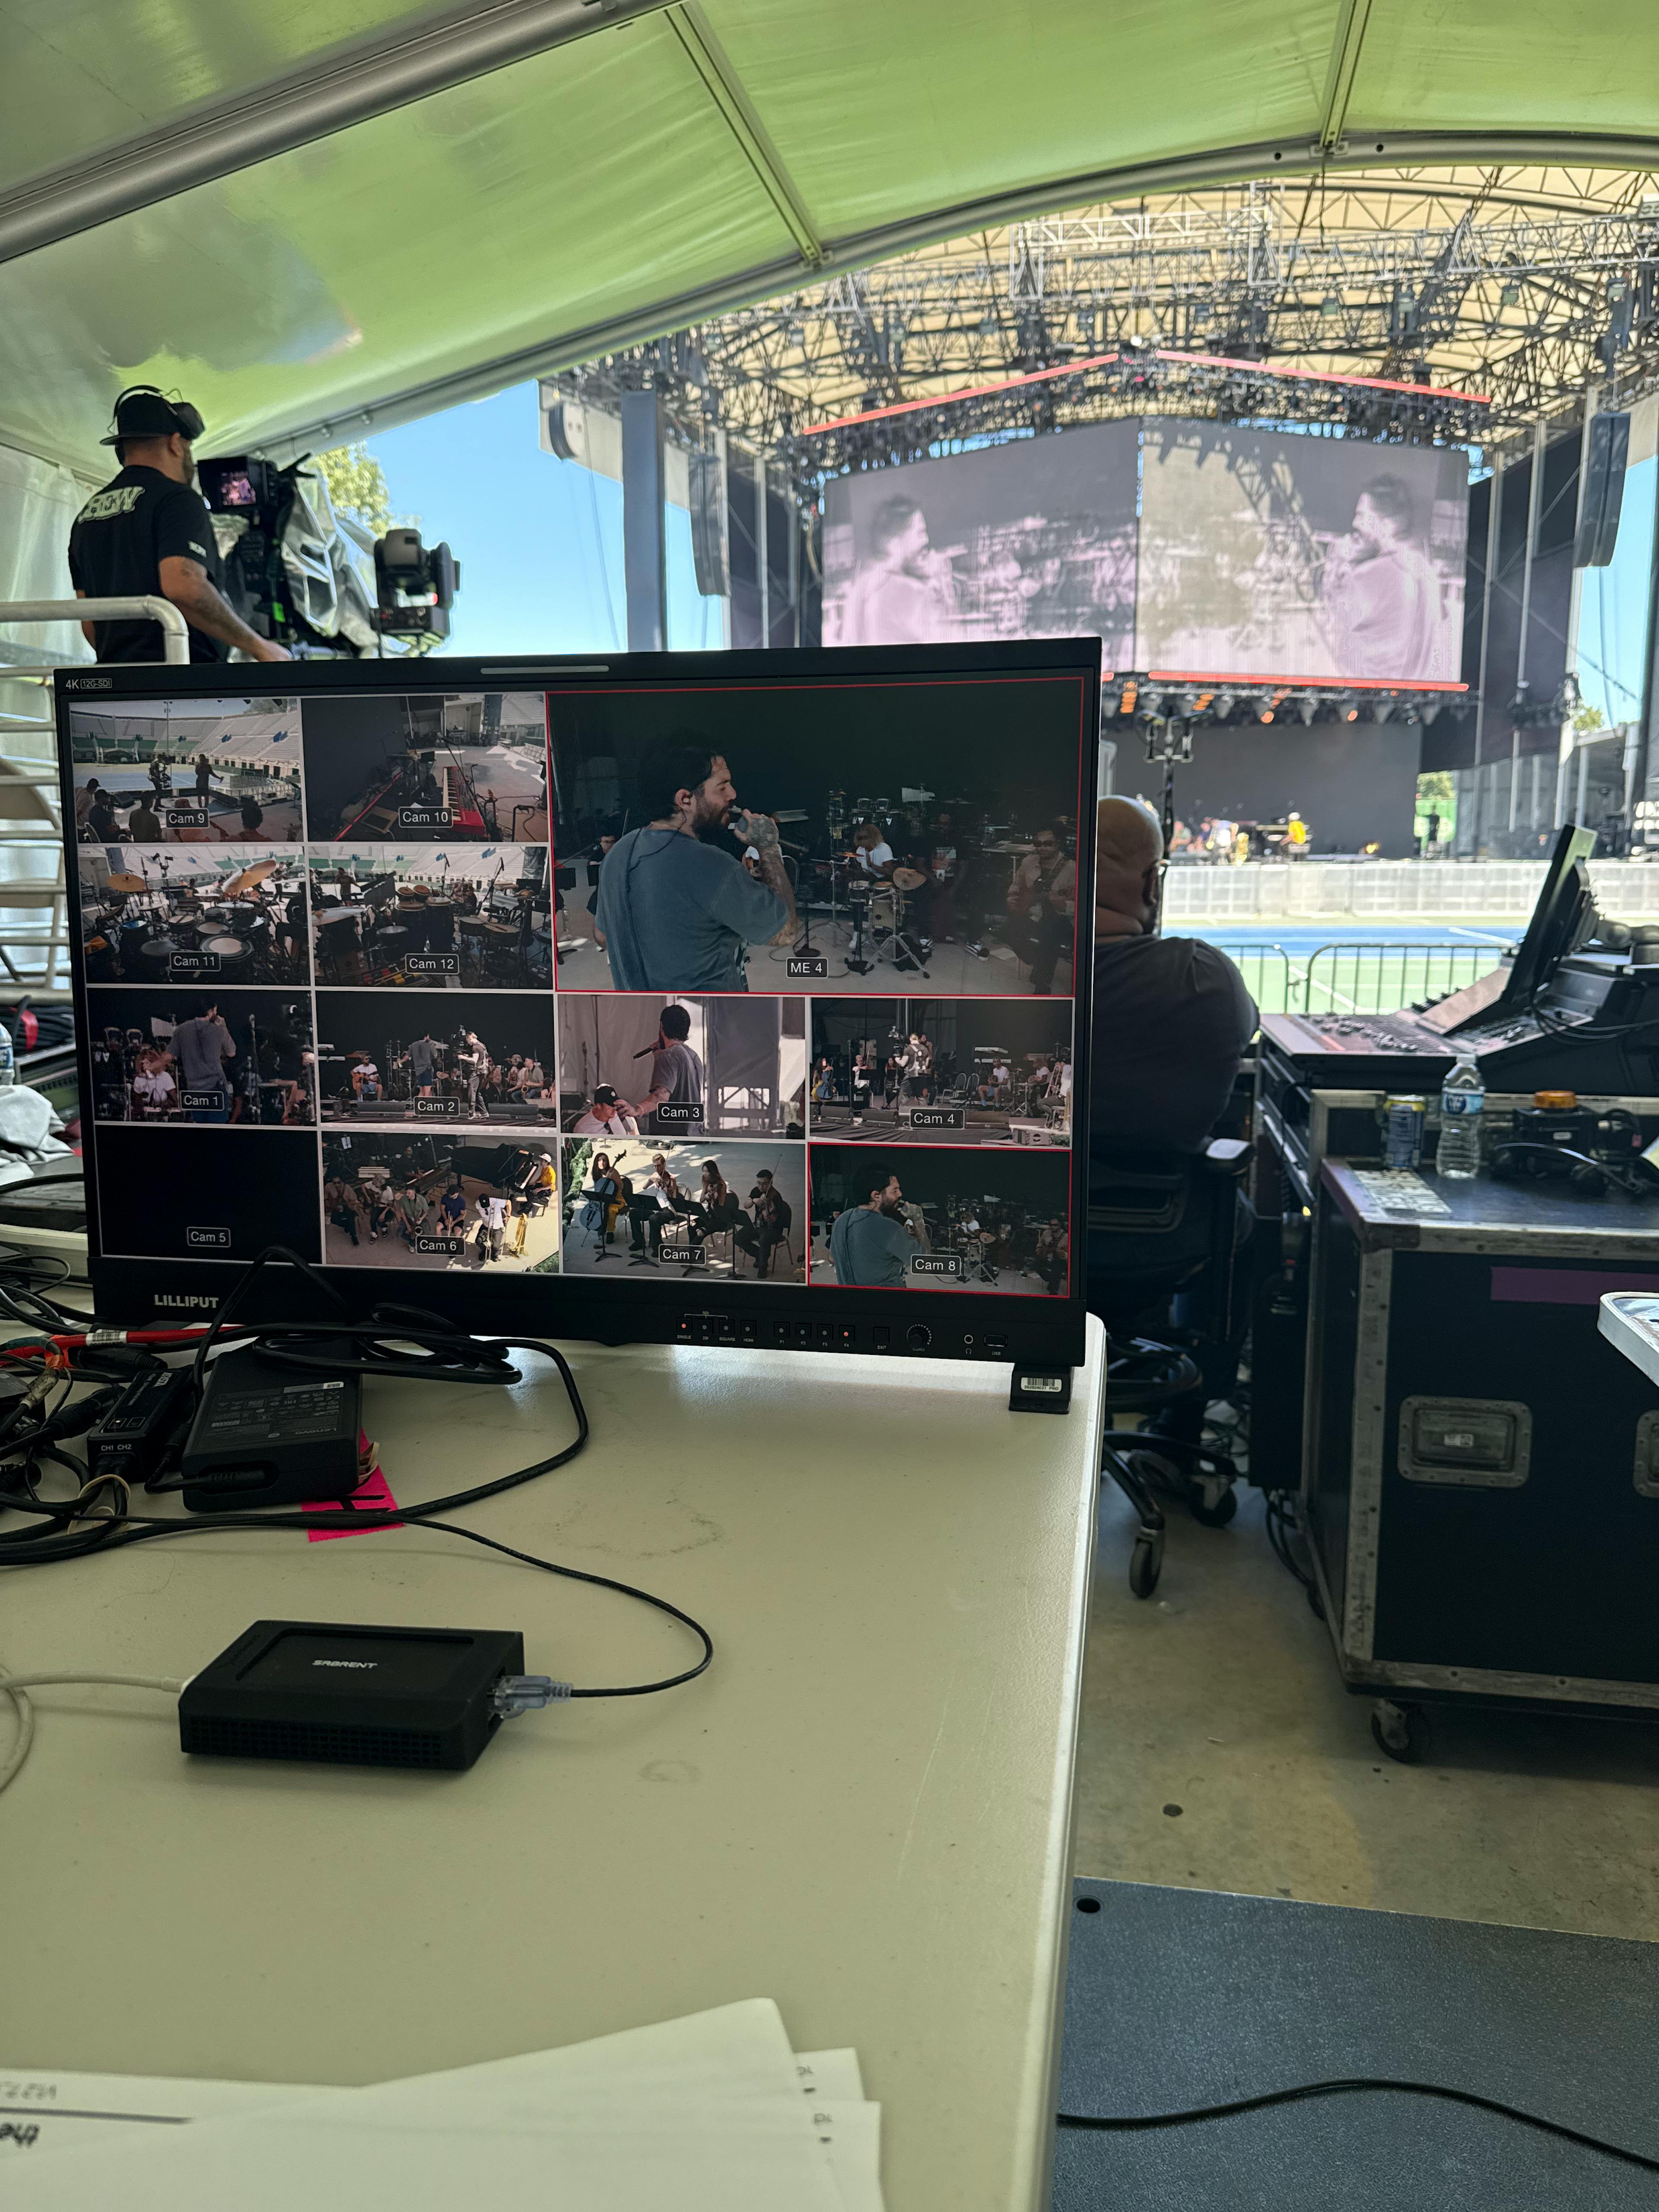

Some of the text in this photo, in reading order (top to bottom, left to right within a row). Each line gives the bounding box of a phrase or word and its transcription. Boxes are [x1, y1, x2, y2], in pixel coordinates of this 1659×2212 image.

[78, 486, 145, 524] REW
[66, 679, 79, 689] 4K
[169, 813, 205, 823] Cam 9
[403, 812, 448, 823] Cam 10
[174, 956, 215, 966] Cam 11
[409, 958, 454, 969] Cam 12
[791, 962, 822, 973] ME 4
[184, 1095, 218, 1106] Cam 1
[418, 1100, 455, 1112] Cam 2
[661, 1107, 699, 1118] Cam 3
[914, 1113, 954, 1124] Cam 4
[191, 1231, 226, 1243] Cam 5
[420, 1240, 457, 1251] Cam 6
[663, 1249, 701, 1260] Cam 7
[915, 1259, 956, 1271] Cam 8
[155, 1294, 219, 1308] LILLIPUT
[312, 1660, 378, 1669] SABRENT
